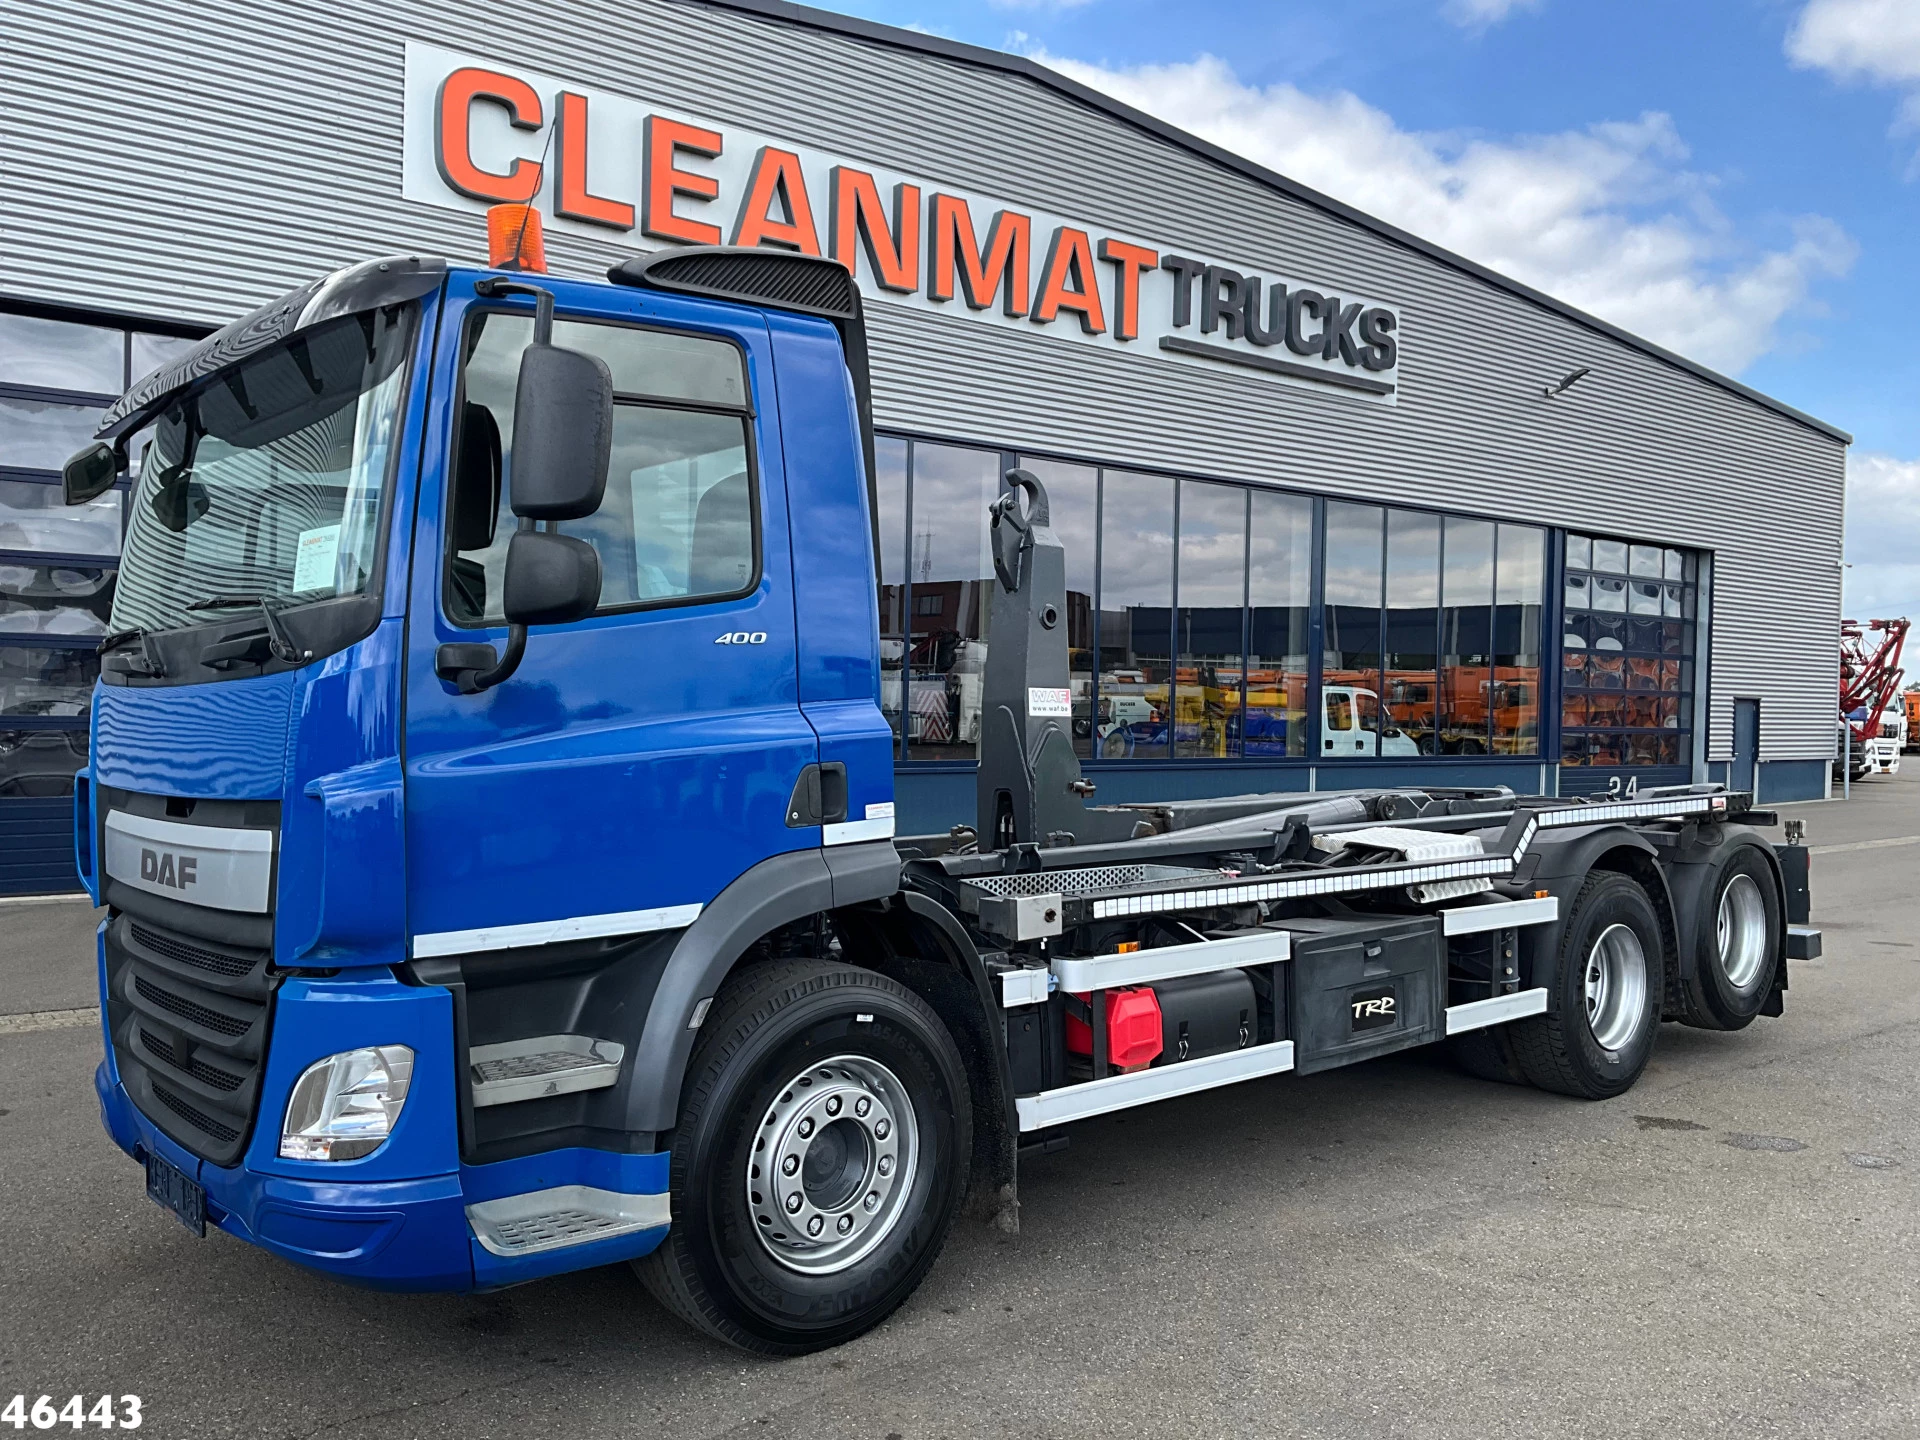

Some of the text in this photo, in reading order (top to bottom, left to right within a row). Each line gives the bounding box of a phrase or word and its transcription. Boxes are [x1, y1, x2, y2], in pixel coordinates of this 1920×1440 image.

[434, 67, 1397, 371] CLEANMAT TRUCKS
[714, 632, 767, 645] 400
[1031, 690, 1068, 703] WAF
[1609, 776, 1637, 799] 24
[141, 847, 197, 890] DAF
[1351, 997, 1396, 1018] TRR
